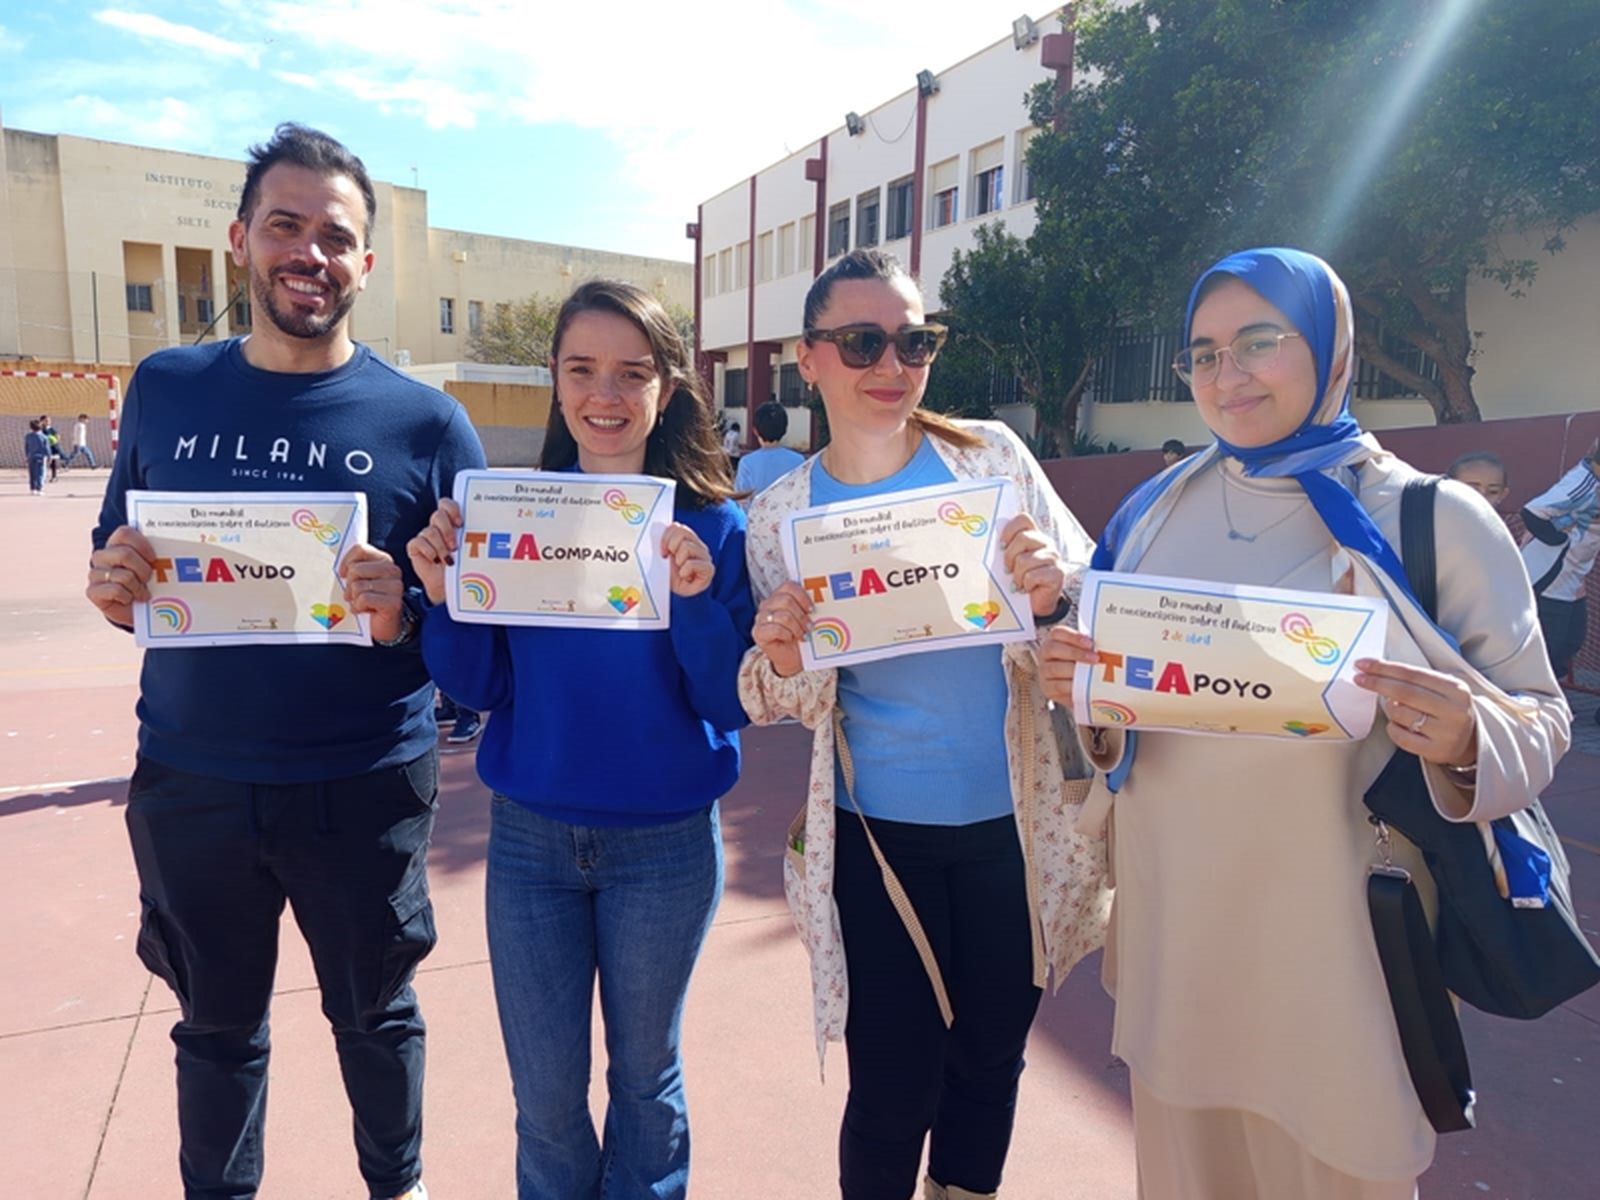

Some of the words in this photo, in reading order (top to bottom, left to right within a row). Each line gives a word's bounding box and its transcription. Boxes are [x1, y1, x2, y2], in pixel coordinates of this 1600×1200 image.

[145, 172, 213, 190] INSTITUTO
[177, 215, 212, 229] SIETE
[174, 433, 374, 475] MILANO
[231, 468, 268, 479] SINCE
[276, 471, 305, 482] 1984
[464, 532, 630, 563] TEACOMPAÑO
[151, 557, 296, 584] TEAYUDO
[803, 563, 960, 604] TEACEPTO
[1105, 602, 1117, 615] de
[1189, 614, 1218, 629] sobre
[1220, 618, 1231, 629] el
[1179, 601, 1223, 615] mundial
[1162, 629, 1170, 641] 2
[1171, 630, 1183, 642] de
[1185, 631, 1212, 645] abril
[1096, 650, 1273, 700] TEAPOYO
